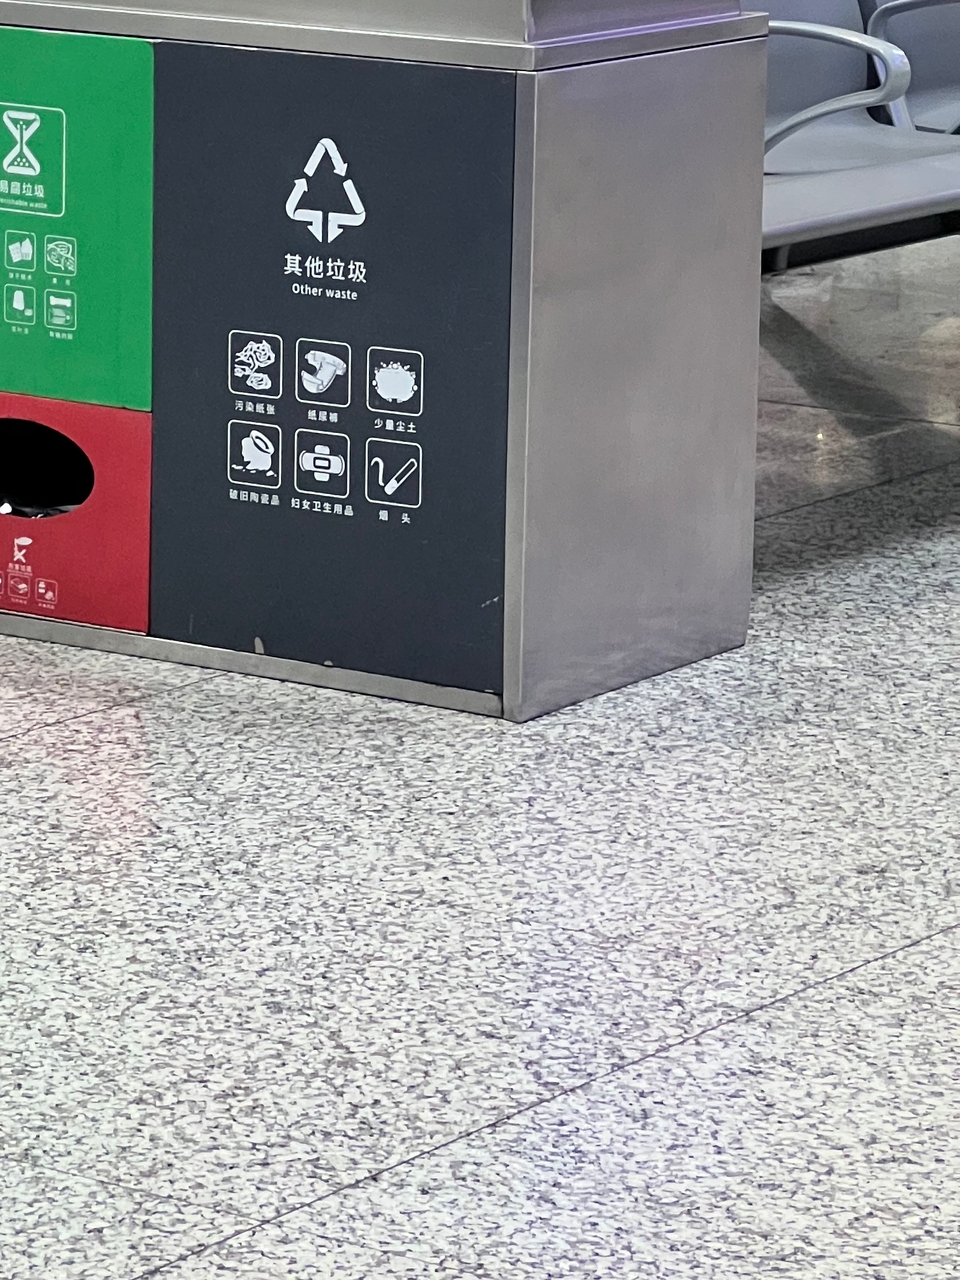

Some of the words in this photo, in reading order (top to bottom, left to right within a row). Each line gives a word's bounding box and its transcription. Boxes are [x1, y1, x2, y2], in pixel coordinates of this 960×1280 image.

[283, 252, 368, 284] 其他垃圾
[291, 282, 324, 297] Other
[325, 287, 358, 301] waste
[234, 399, 276, 416] 污染纸张
[307, 409, 339, 423] 纸尿裤
[373, 417, 418, 434] 少量尘土
[228, 488, 281, 507] 破旧陶瓷品
[290, 497, 355, 517] 妇女卫生用品
[377, 508, 412, 525] 烟头
